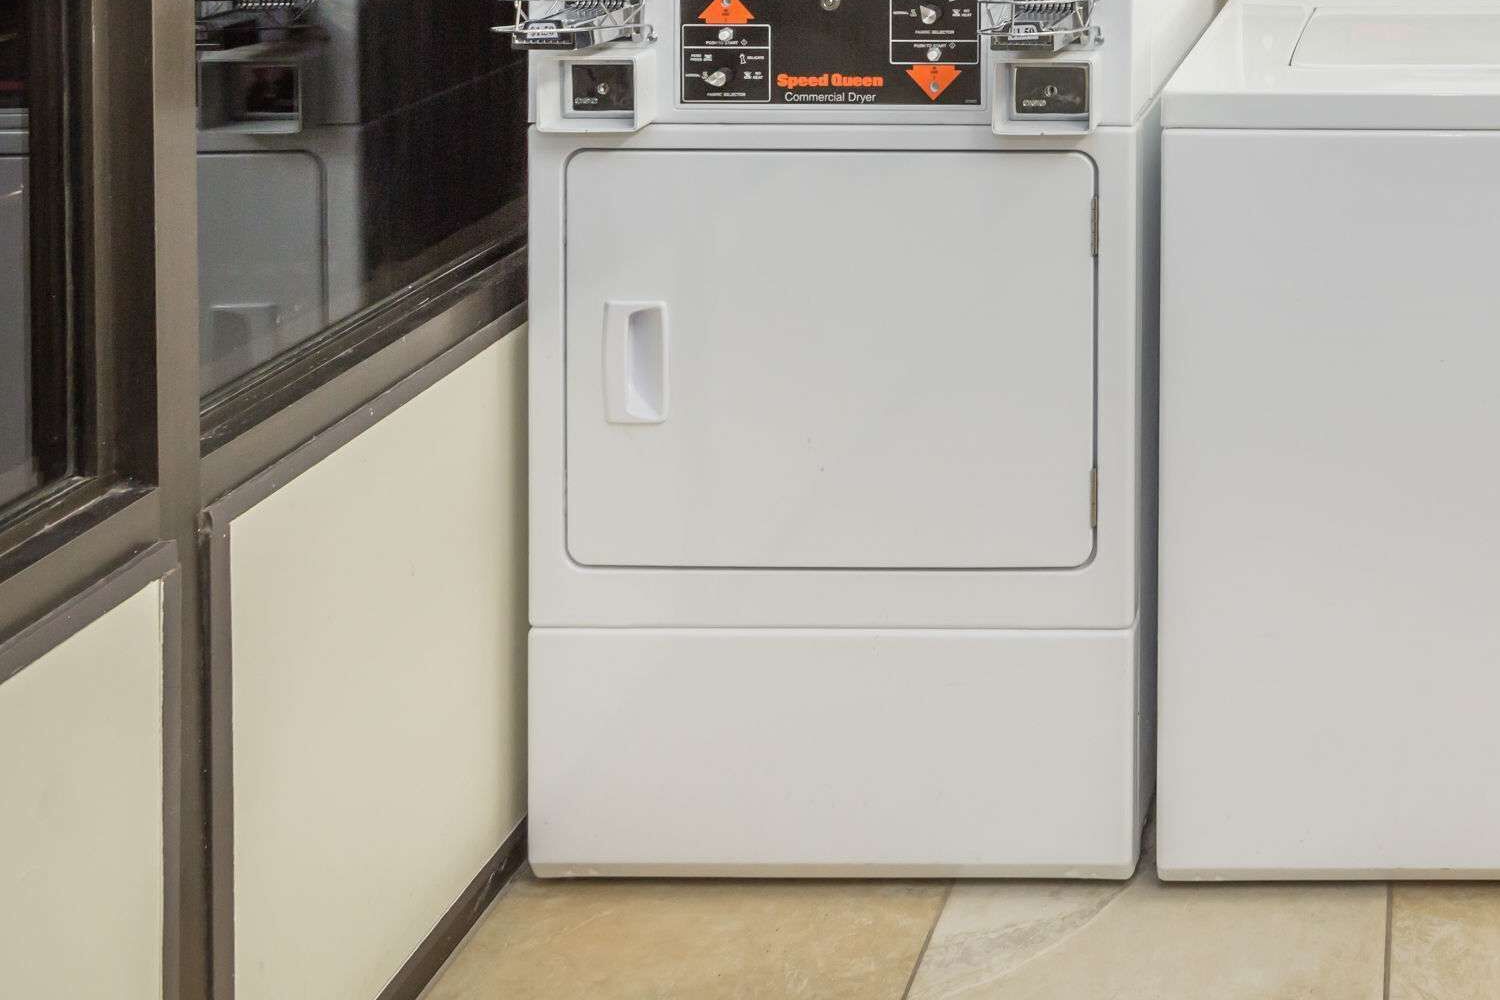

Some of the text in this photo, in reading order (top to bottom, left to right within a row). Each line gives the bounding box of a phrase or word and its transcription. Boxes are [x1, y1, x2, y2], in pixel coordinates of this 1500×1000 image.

[776, 73, 884, 89] Speed Queen
[784, 91, 876, 104] Commercial Dryer
